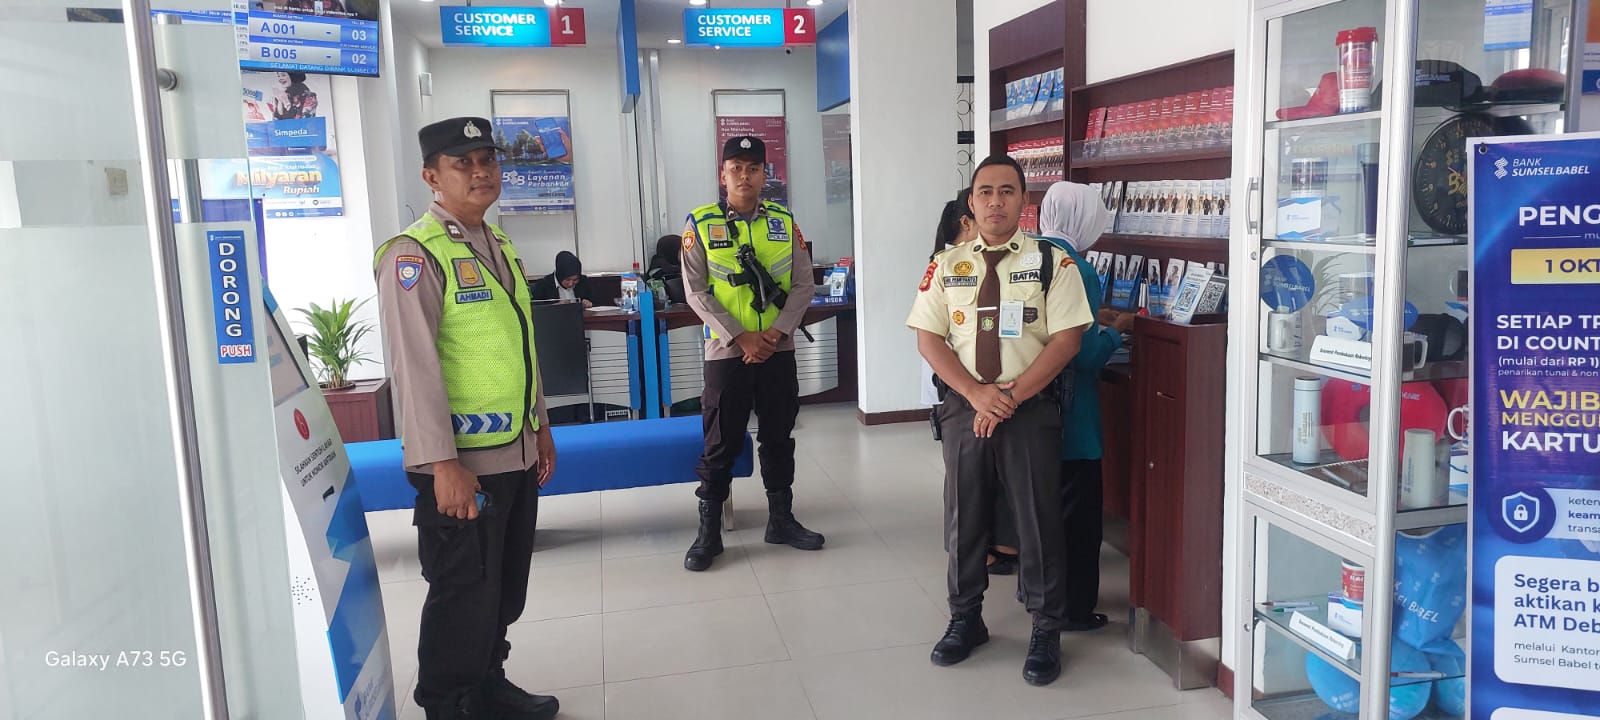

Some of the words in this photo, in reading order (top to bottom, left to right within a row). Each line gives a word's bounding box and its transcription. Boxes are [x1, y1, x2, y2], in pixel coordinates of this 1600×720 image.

[454, 13, 536, 25] CUSTOMER
[561, 15, 574, 35] 1
[698, 15, 771, 25] CUSTOMER
[793, 15, 806, 34] 2
[351, 29, 367, 41] 03
[455, 25, 514, 37] SERVICE
[698, 26, 752, 37] SERVICE
[351, 53, 367, 65] 02
[270, 62, 298, 70] SELAMAT
[274, 128, 308, 137] Simpeda
[1512, 158, 1542, 168] BANK
[1511, 165, 1591, 177] SUMSELBABEL
[236, 168, 322, 188] Milyaran
[527, 174, 566, 182] Layanan
[283, 185, 320, 195] Rupiah
[1519, 204, 1600, 226] PENG
[1545, 259, 1553, 273] 1
[1559, 258, 1600, 273] OKT
[1012, 270, 1040, 281] SATPA
[218, 242, 242, 337] DORONG
[460, 291, 490, 301] AHMADI
[1496, 315, 1573, 329] SETIAP
[1497, 335, 1519, 350] DI
[1525, 336, 1600, 350] COUNT
[221, 345, 252, 357] PUSH
[1498, 356, 1537, 367] (mulai
[1540, 357, 1564, 366] dari
[1568, 357, 1586, 367] RP
[1589, 357, 1600, 368] 1)
[1498, 369, 1543, 377] penarikan
[1545, 369, 1569, 377] tunai
[1500, 390, 1600, 411] WAJIB
[1502, 412, 1600, 428] MENGGU
[1502, 431, 1600, 453] KARTU
[1568, 510, 1600, 519] keam
[1514, 573, 1581, 593] Segera
[1587, 577, 1600, 593] b
[1514, 593, 1586, 612] aktikan
[1514, 613, 1556, 630] ATM
[1563, 617, 1600, 634] Deb
[1514, 642, 1556, 652] melalui
[1561, 645, 1600, 656] Kantor
[1514, 654, 1555, 666] Sumsel
[1558, 658, 1592, 669] Babel
